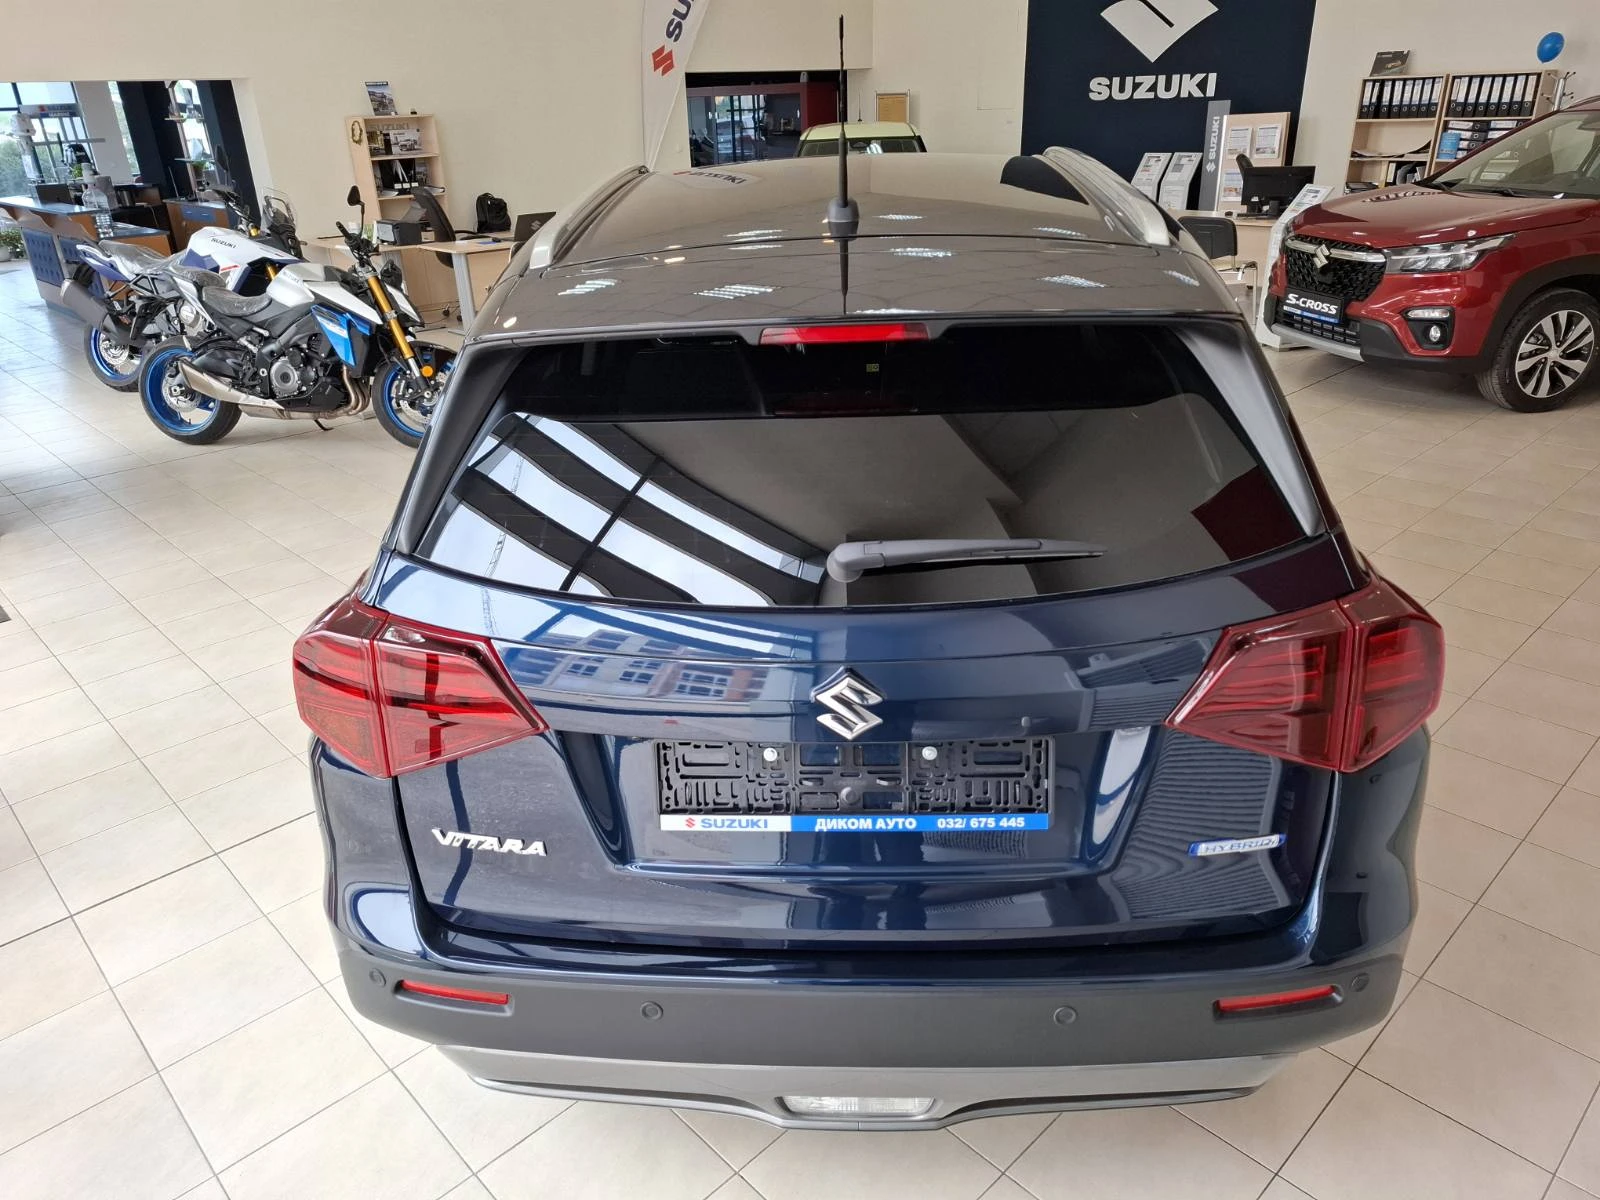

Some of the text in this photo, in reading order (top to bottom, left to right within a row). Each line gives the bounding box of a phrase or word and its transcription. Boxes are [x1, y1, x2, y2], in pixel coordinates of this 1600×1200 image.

[1089, 72, 1217, 101] SUZUKI
[1209, 116, 1221, 160] SUZUKI
[211, 238, 237, 249] SUZUKI
[1285, 293, 1338, 315] S-CROSS
[701, 817, 768, 829] SUZUKI
[815, 817, 917, 832] ДИКОМ АУТО
[937, 817, 1025, 829] 032/ 675 445
[431, 828, 547, 856] VITARA
[1205, 838, 1274, 852] HYBRID
